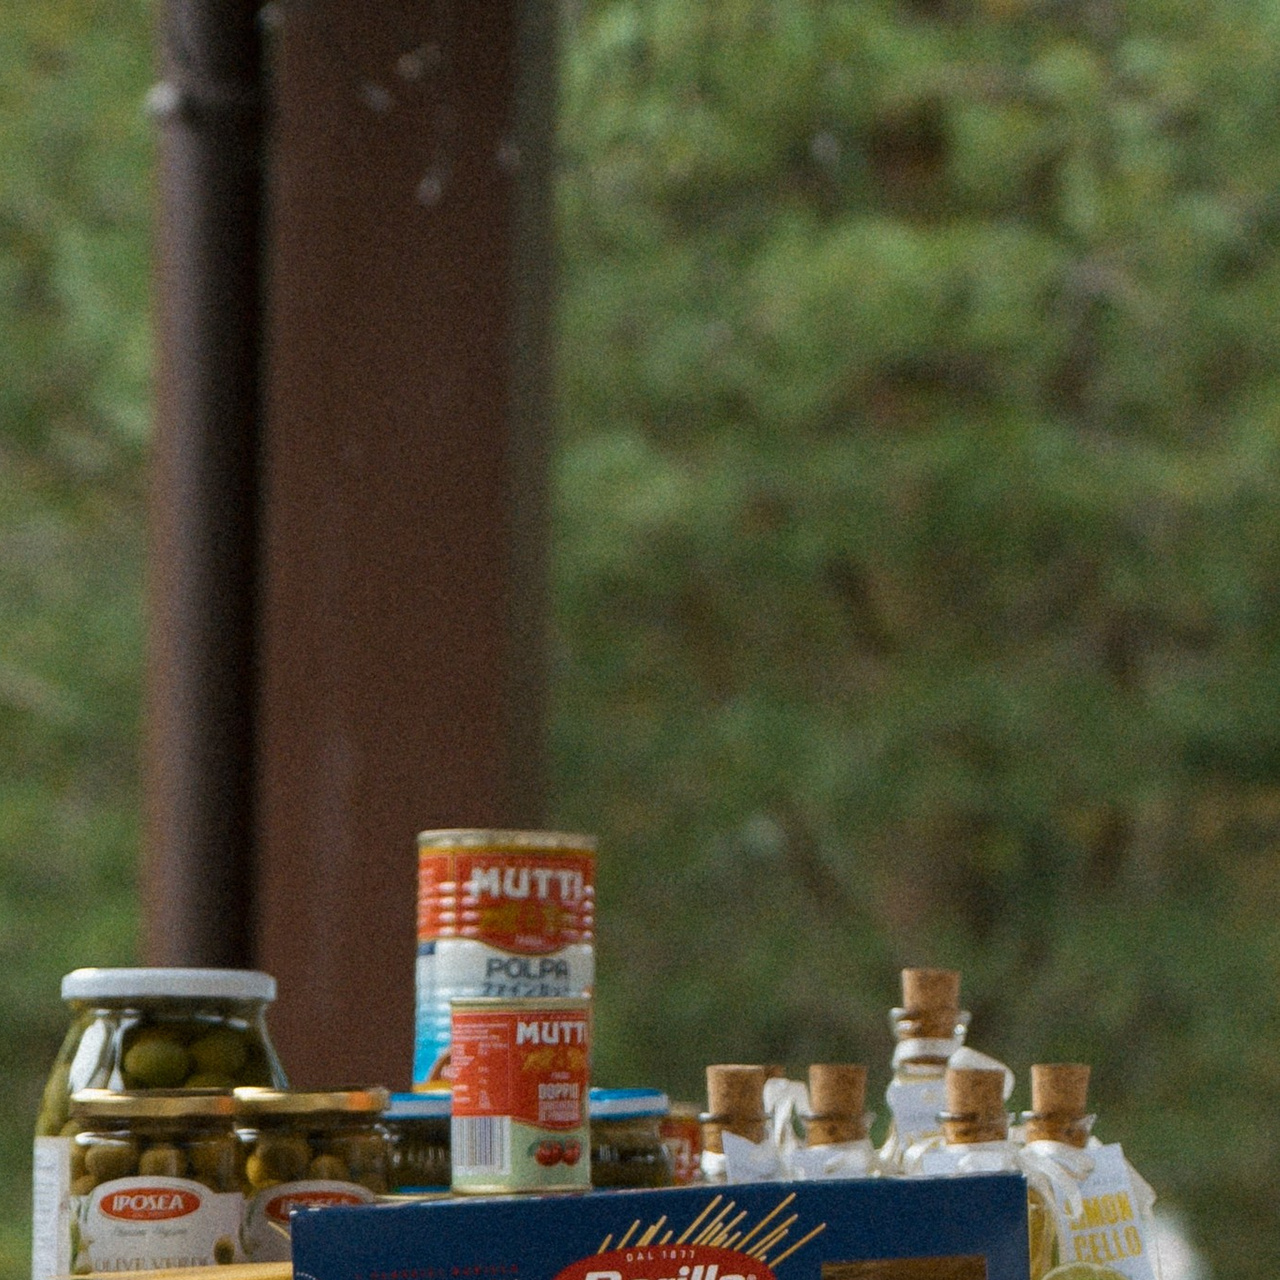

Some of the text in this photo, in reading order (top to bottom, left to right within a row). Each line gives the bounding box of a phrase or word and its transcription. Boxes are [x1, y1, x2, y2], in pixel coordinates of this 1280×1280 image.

[470, 867, 583, 899] MUTTI
[486, 957, 569, 979] POLPA
[112, 1194, 185, 1212] IPOSEA
[626, 1250, 695, 1262] DAL 1877
[1073, 1225, 1143, 1265] CELLO
